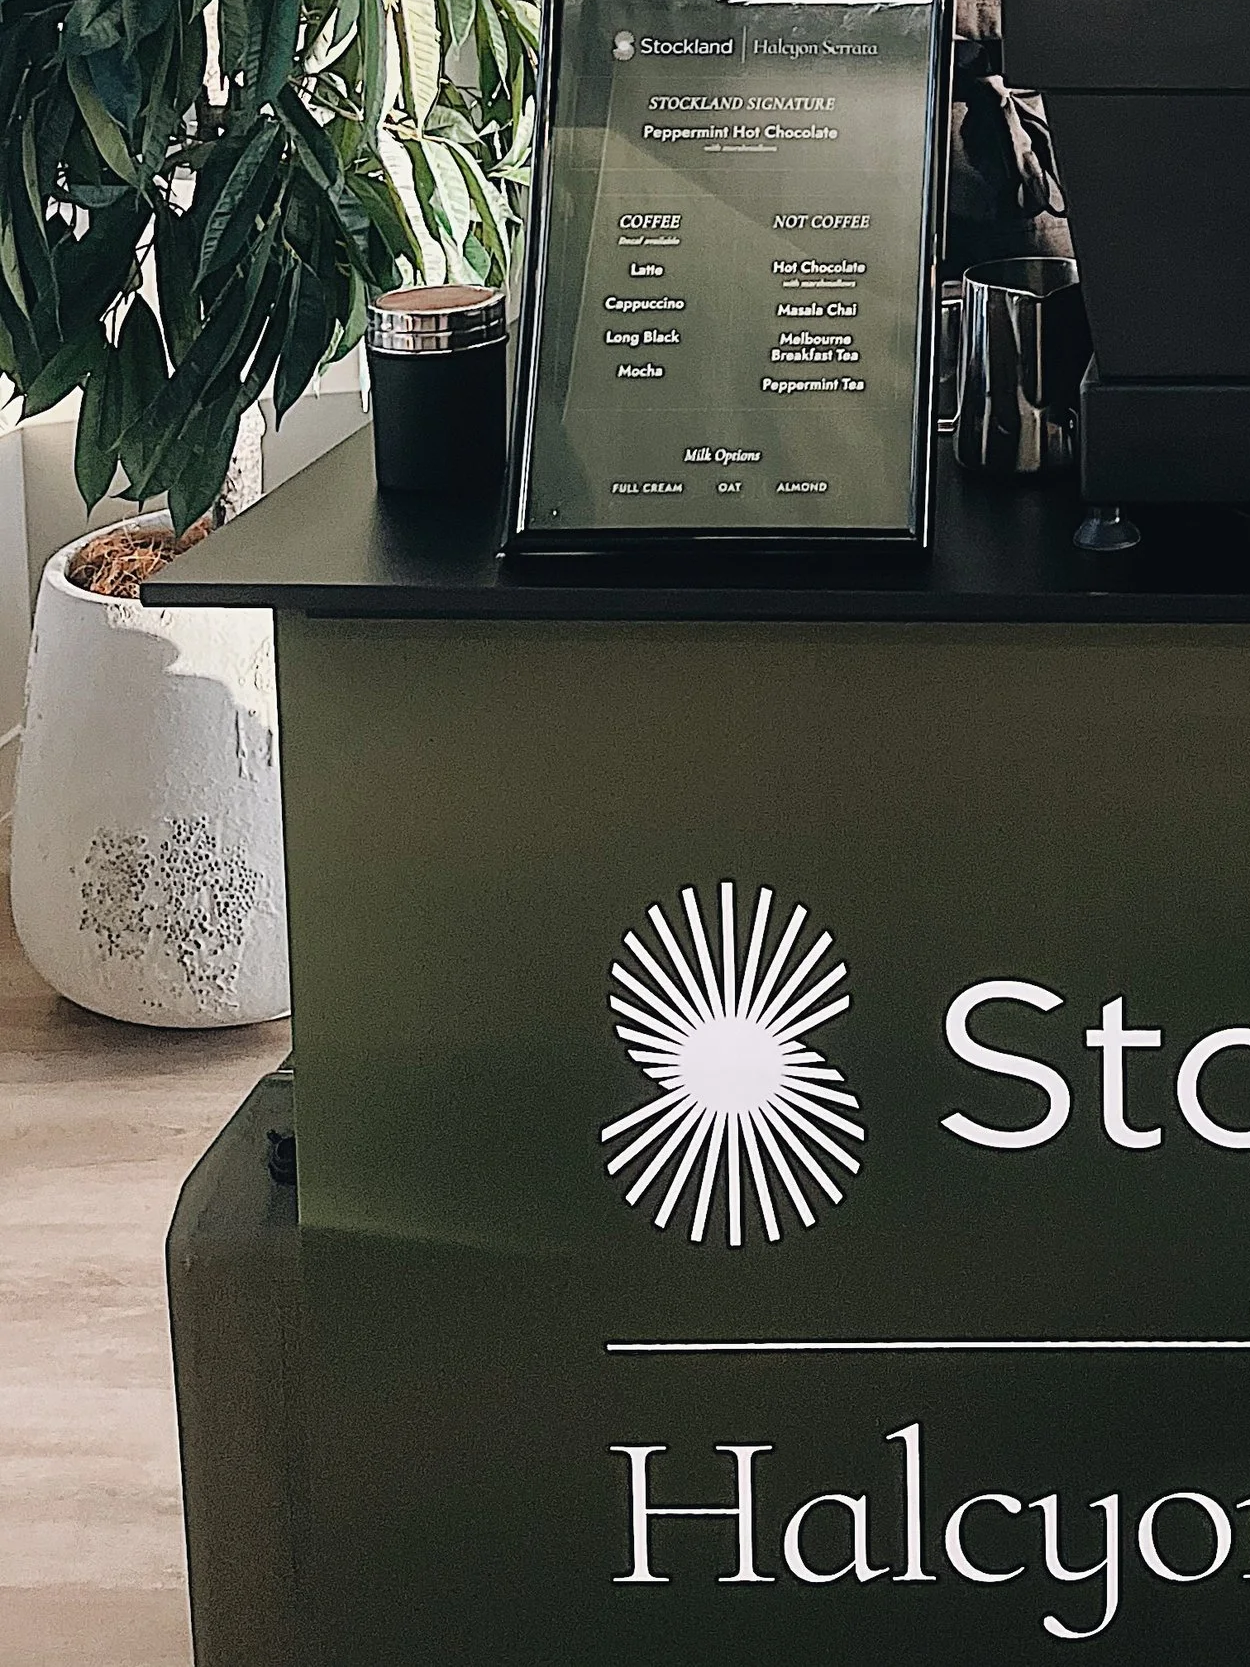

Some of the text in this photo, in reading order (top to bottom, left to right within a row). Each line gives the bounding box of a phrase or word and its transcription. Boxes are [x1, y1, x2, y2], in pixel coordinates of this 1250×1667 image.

[640, 38, 734, 55] Stockland
[753, 39, 878, 60] Halcyon Serrata
[649, 97, 836, 111] STOCKLAND SIGNATURE
[643, 125, 838, 142] Peppermint Hot Chocolate
[620, 215, 681, 229] COFFEE
[773, 215, 870, 229] NOT COFFEE
[631, 263, 664, 276] Latte
[773, 260, 866, 274] Hot Chocolate
[605, 297, 685, 312] Cappuccino
[777, 303, 857, 316] Masala Chai
[606, 330, 680, 346] Long Black
[780, 332, 852, 345] Melbourne
[771, 349, 859, 362] Breakfast Tea
[618, 364, 663, 377] Mocha
[762, 378, 865, 394] Peppermint Tea
[684, 448, 761, 465] Milk Options
[612, 484, 683, 493] FULL CREAM
[718, 483, 741, 493] OAT
[776, 483, 828, 492] ALMOND
